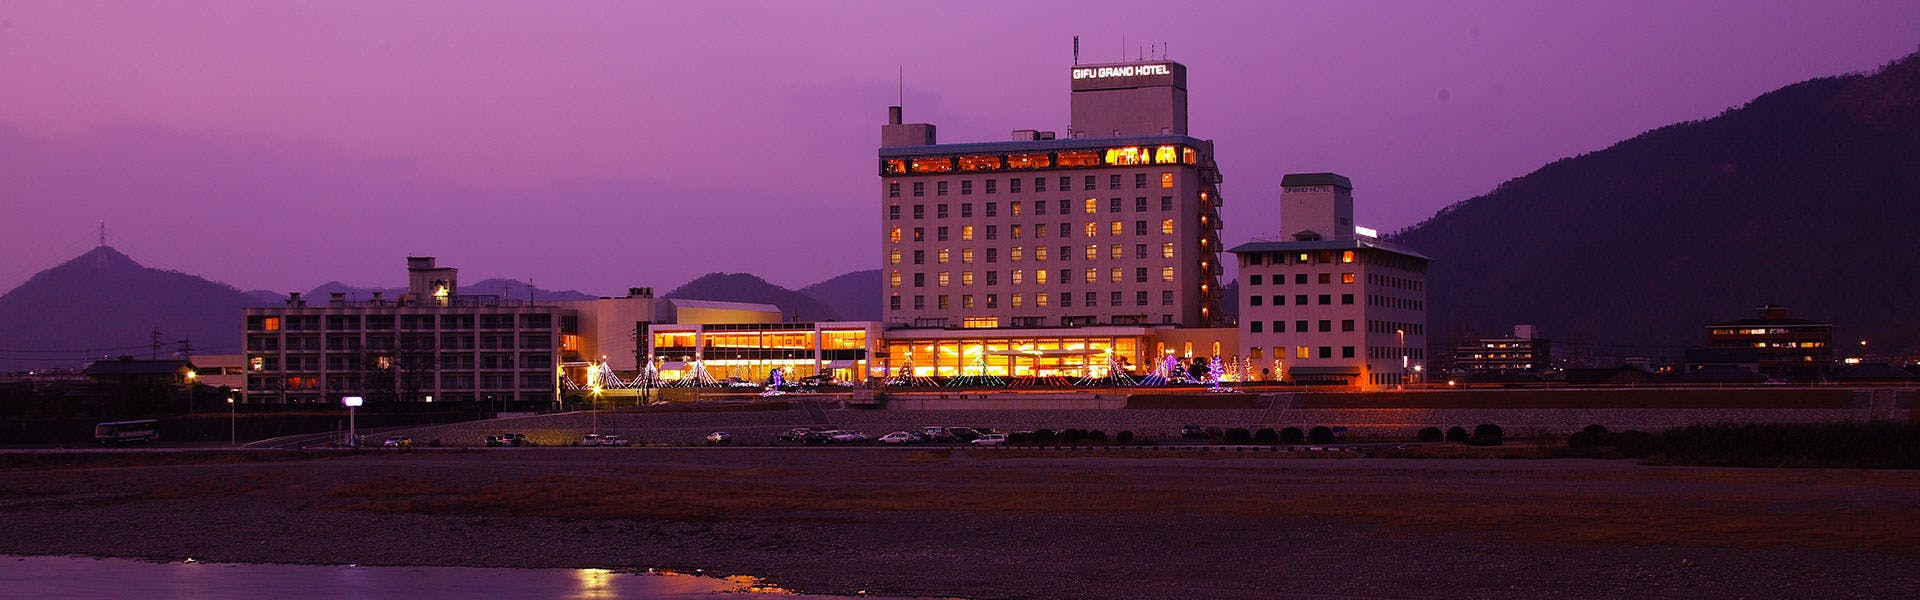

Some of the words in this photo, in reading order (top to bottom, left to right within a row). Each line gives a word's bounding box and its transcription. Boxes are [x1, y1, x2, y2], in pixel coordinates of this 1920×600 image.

[1073, 69, 1096, 79] GIFU
[1098, 67, 1133, 78] GRAND
[1135, 65, 1170, 76] HOTEL
